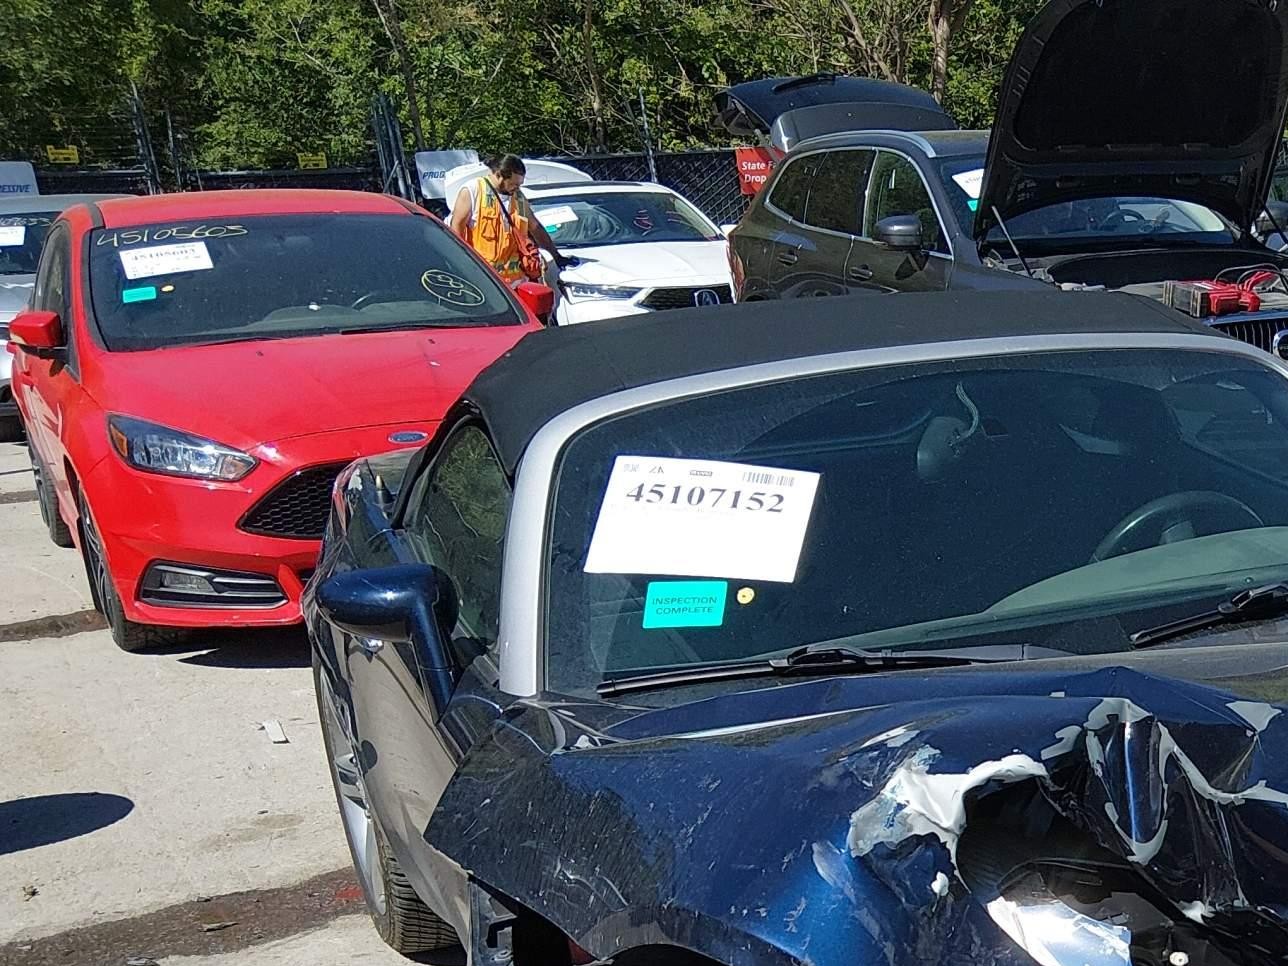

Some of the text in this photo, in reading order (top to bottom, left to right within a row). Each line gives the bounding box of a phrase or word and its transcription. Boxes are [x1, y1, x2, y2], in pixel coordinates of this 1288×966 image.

[741, 161, 766, 171] State
[422, 170, 446, 180] PROG
[744, 173, 767, 185] Drop
[626, 482, 785, 513] 45107152
[652, 596, 718, 605] INSPECTION
[655, 606, 714, 615] COMPLETE
